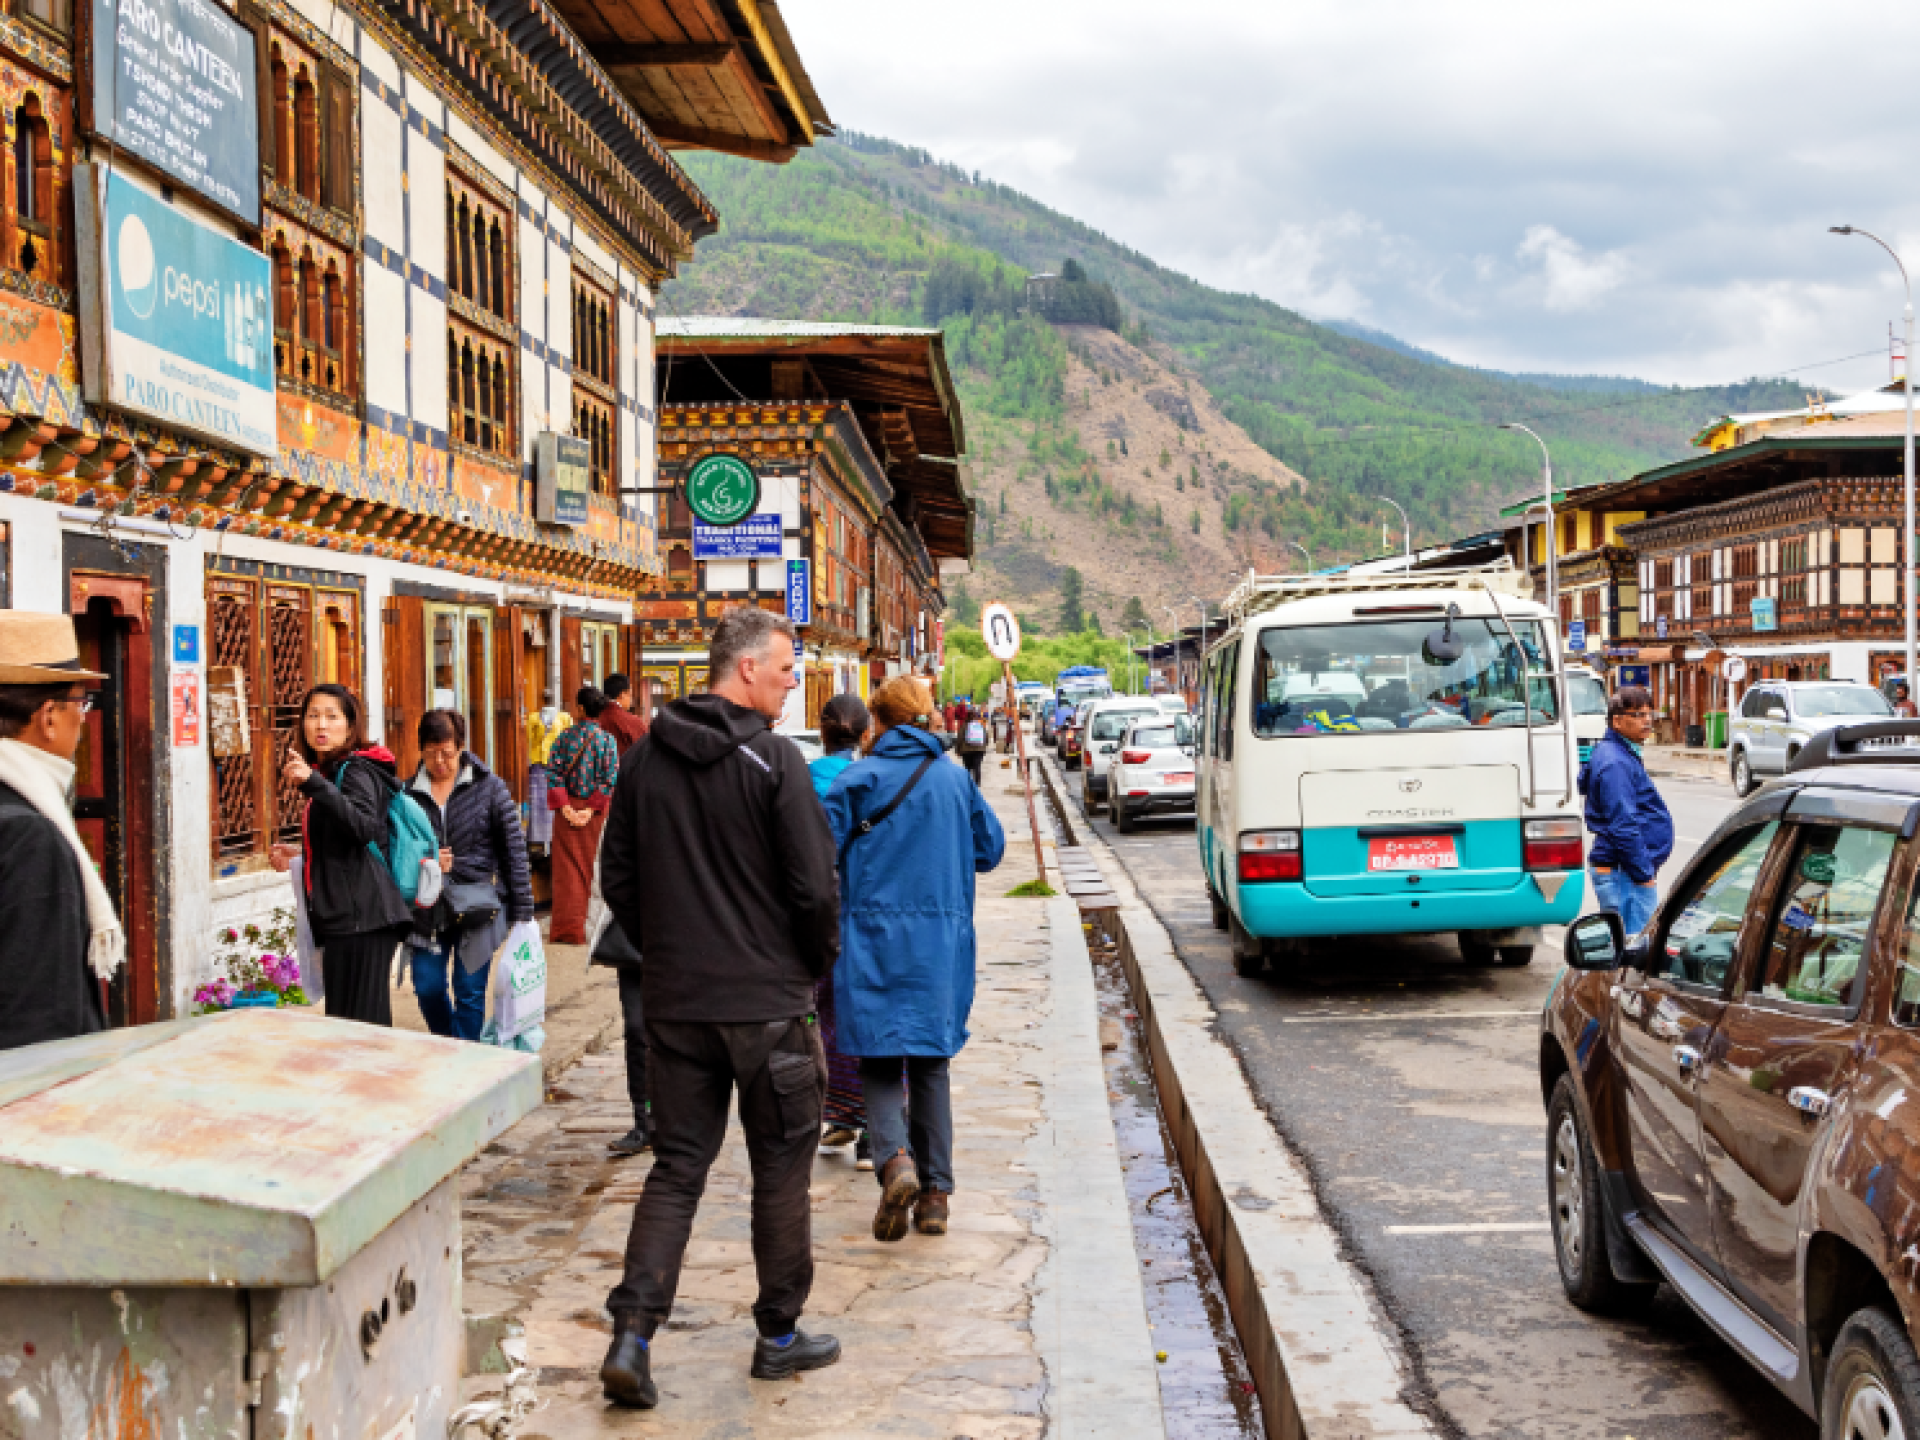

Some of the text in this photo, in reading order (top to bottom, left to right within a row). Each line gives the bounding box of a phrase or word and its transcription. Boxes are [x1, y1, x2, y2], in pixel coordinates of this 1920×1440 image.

[105, 0, 243, 101] ARO CANTEEN
[126, 106, 161, 140] PARO
[164, 265, 220, 320] pepsi
[125, 373, 169, 413] PARO
[172, 391, 241, 436] CANTEEN
